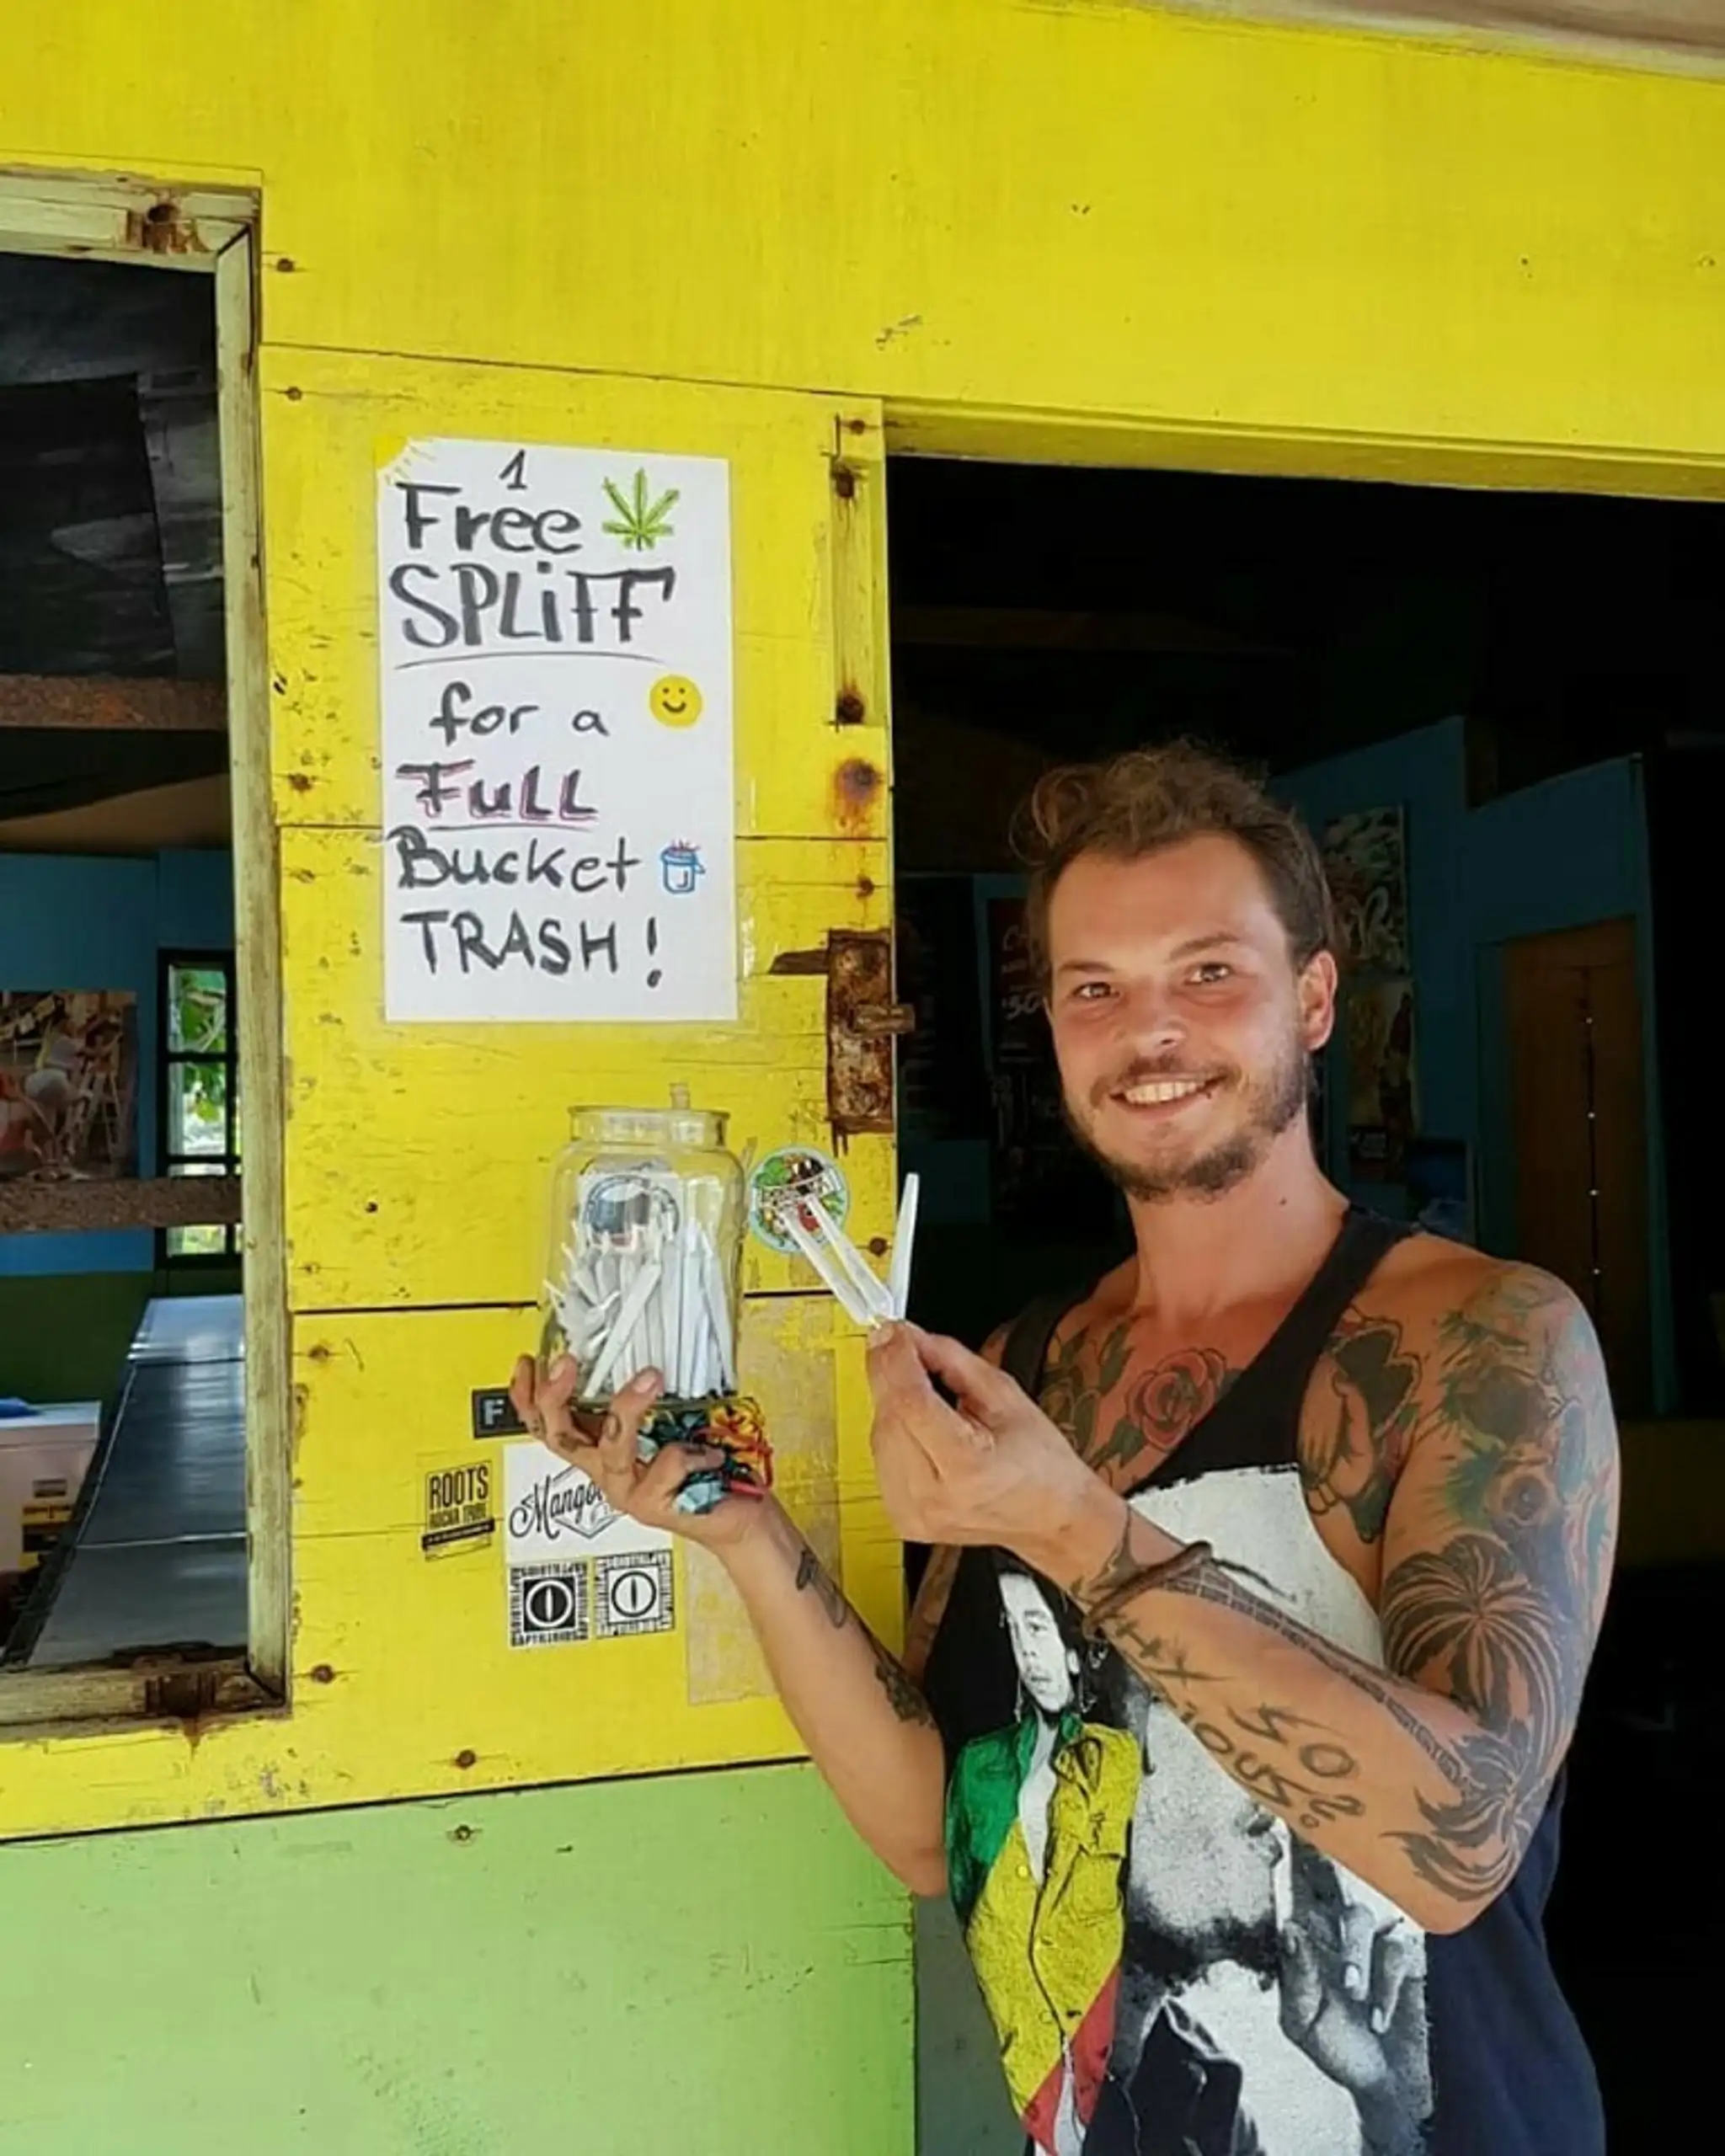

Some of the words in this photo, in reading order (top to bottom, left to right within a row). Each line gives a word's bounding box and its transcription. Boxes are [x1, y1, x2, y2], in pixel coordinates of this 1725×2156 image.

[499, 449, 528, 490] 1
[395, 480, 582, 555] Free
[429, 681, 540, 746] for
[572, 710, 609, 736] a
[387, 824, 640, 893] Bucket
[430, 1465, 489, 1510] ROOTS
